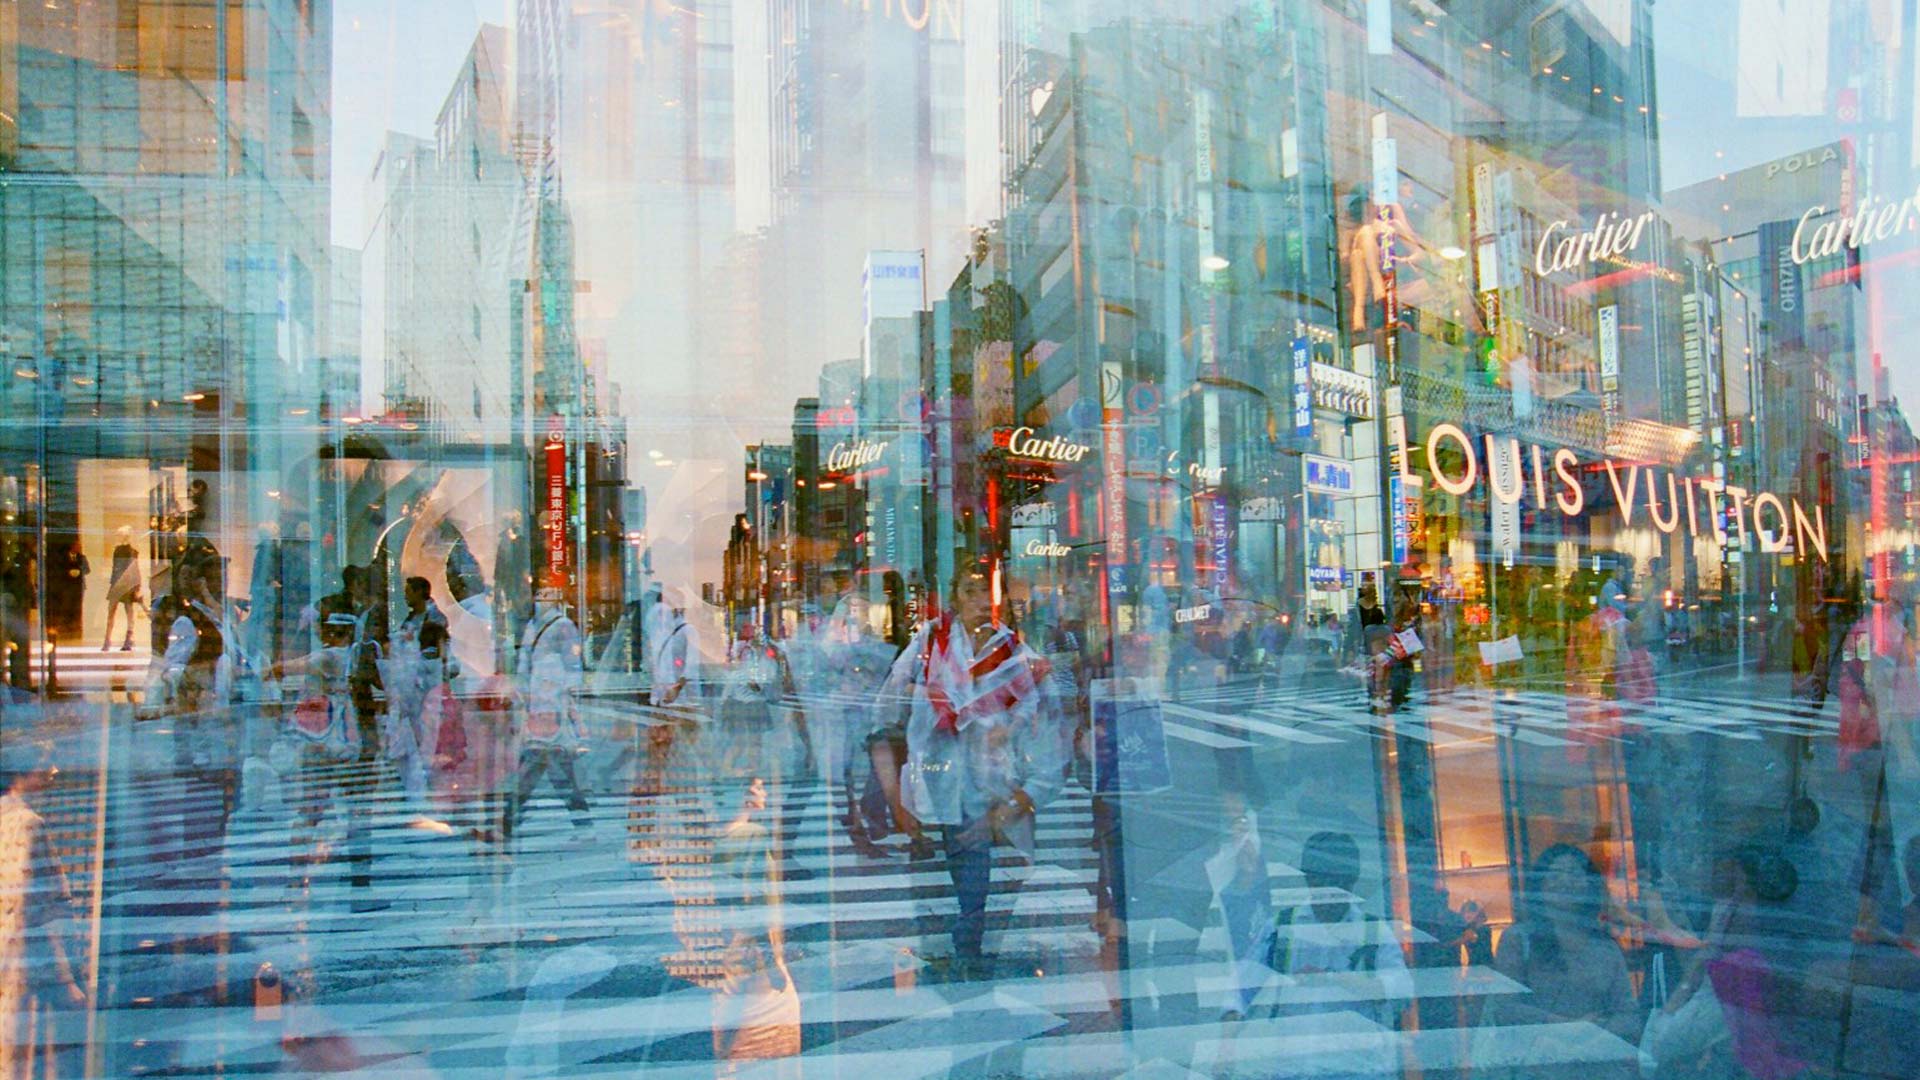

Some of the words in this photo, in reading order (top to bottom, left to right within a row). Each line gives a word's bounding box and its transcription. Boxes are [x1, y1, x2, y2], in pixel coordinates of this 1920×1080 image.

[1766, 147, 1838, 179] POLA
[1535, 211, 1654, 276] Cartier
[1791, 195, 1917, 264] Cartier
[828, 440, 889, 472] Cartier
[1008, 426, 1090, 462] Cartier
[1398, 415, 1584, 516] LOUIS
[1604, 459, 1828, 564] VUITTON
[1026, 539, 1072, 557] Cartier
[1214, 502, 1228, 583] CHAUMET
